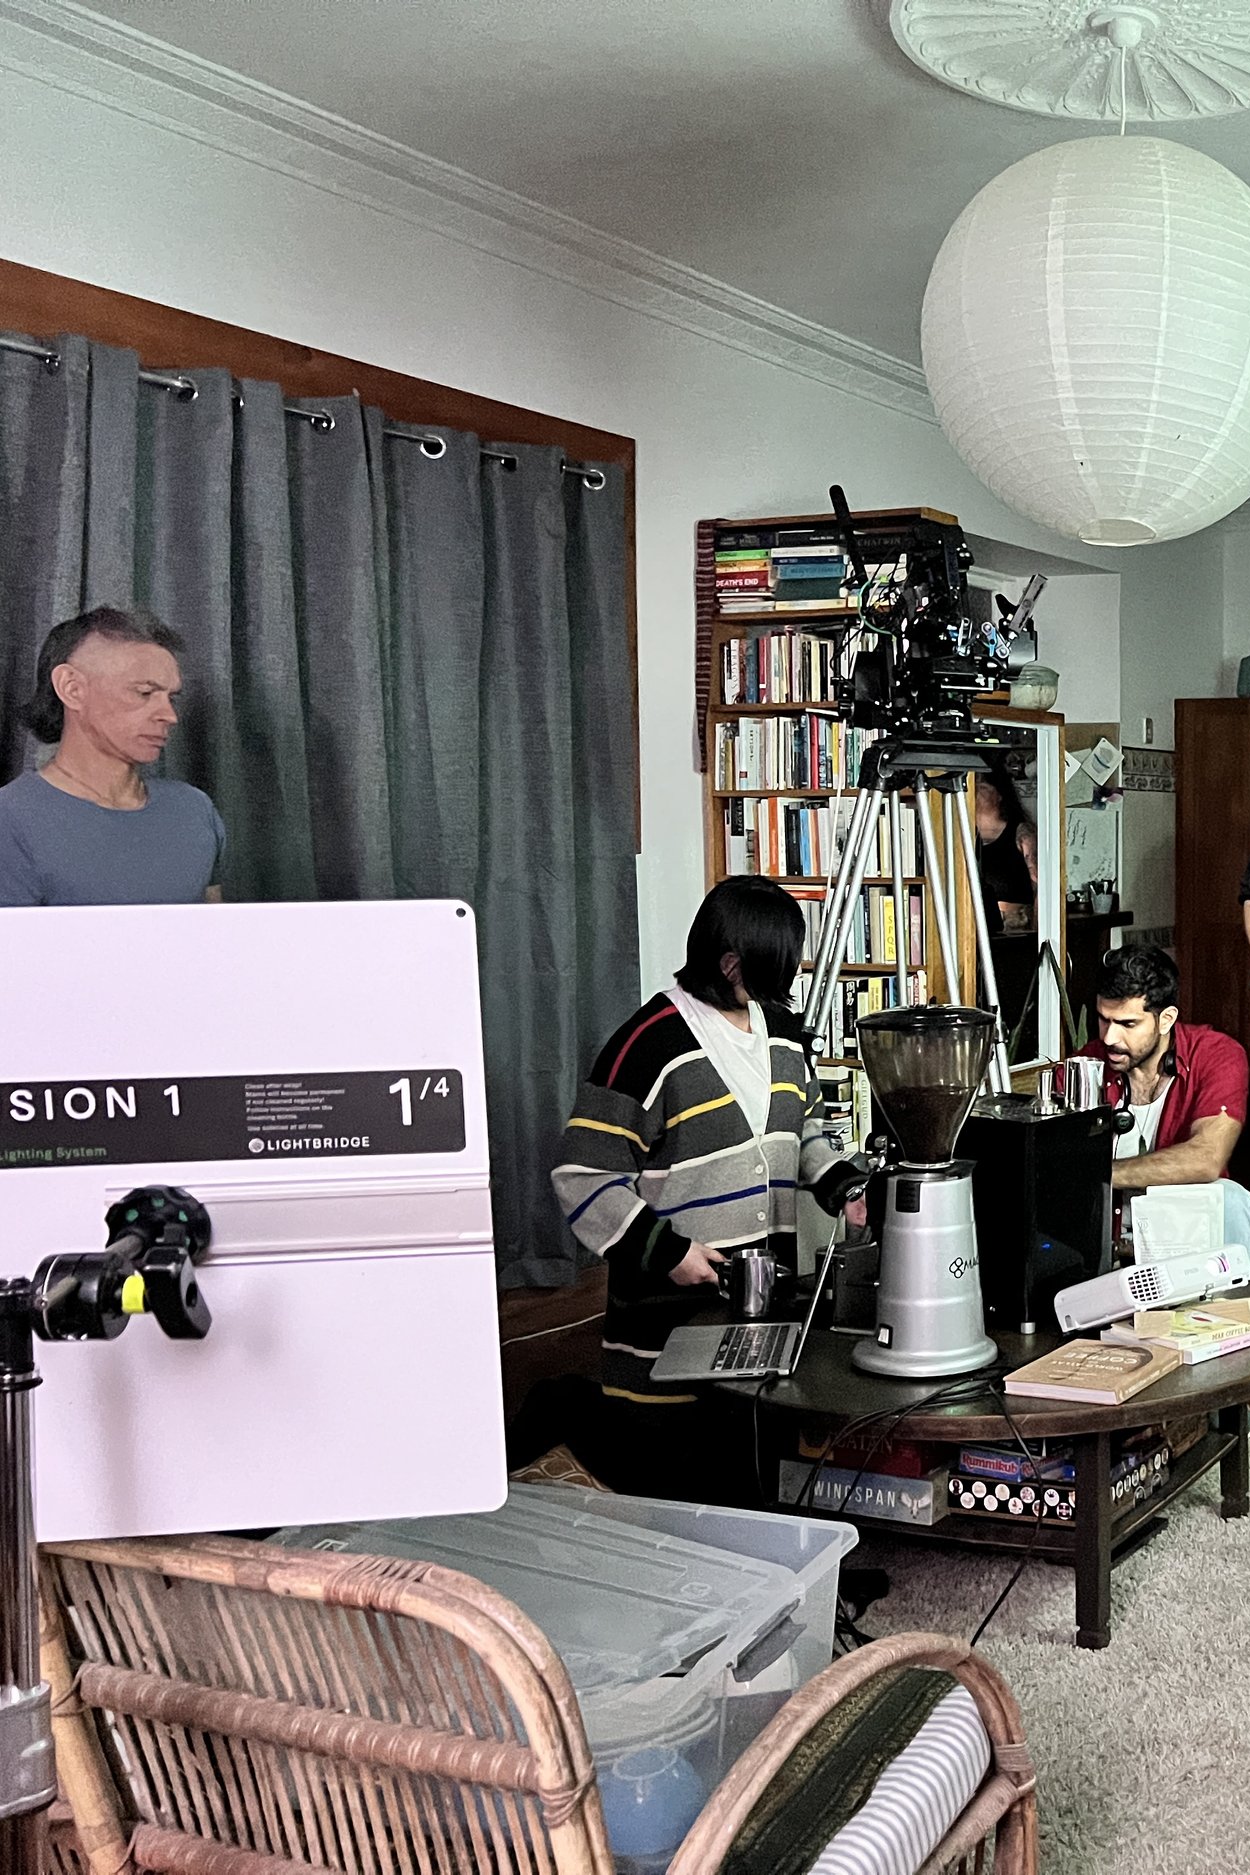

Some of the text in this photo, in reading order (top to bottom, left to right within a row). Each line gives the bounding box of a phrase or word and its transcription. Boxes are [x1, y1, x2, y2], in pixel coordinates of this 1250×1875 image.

[716, 577, 759, 587] DEATH'S END
[9, 1085, 180, 1122] SION 1
[267, 1136, 370, 1150] LIGHTBRIDGE
[56, 1147, 107, 1161] System
[962, 1452, 1019, 1475] Rummikub
[813, 1480, 896, 1508] WINGSPAN
